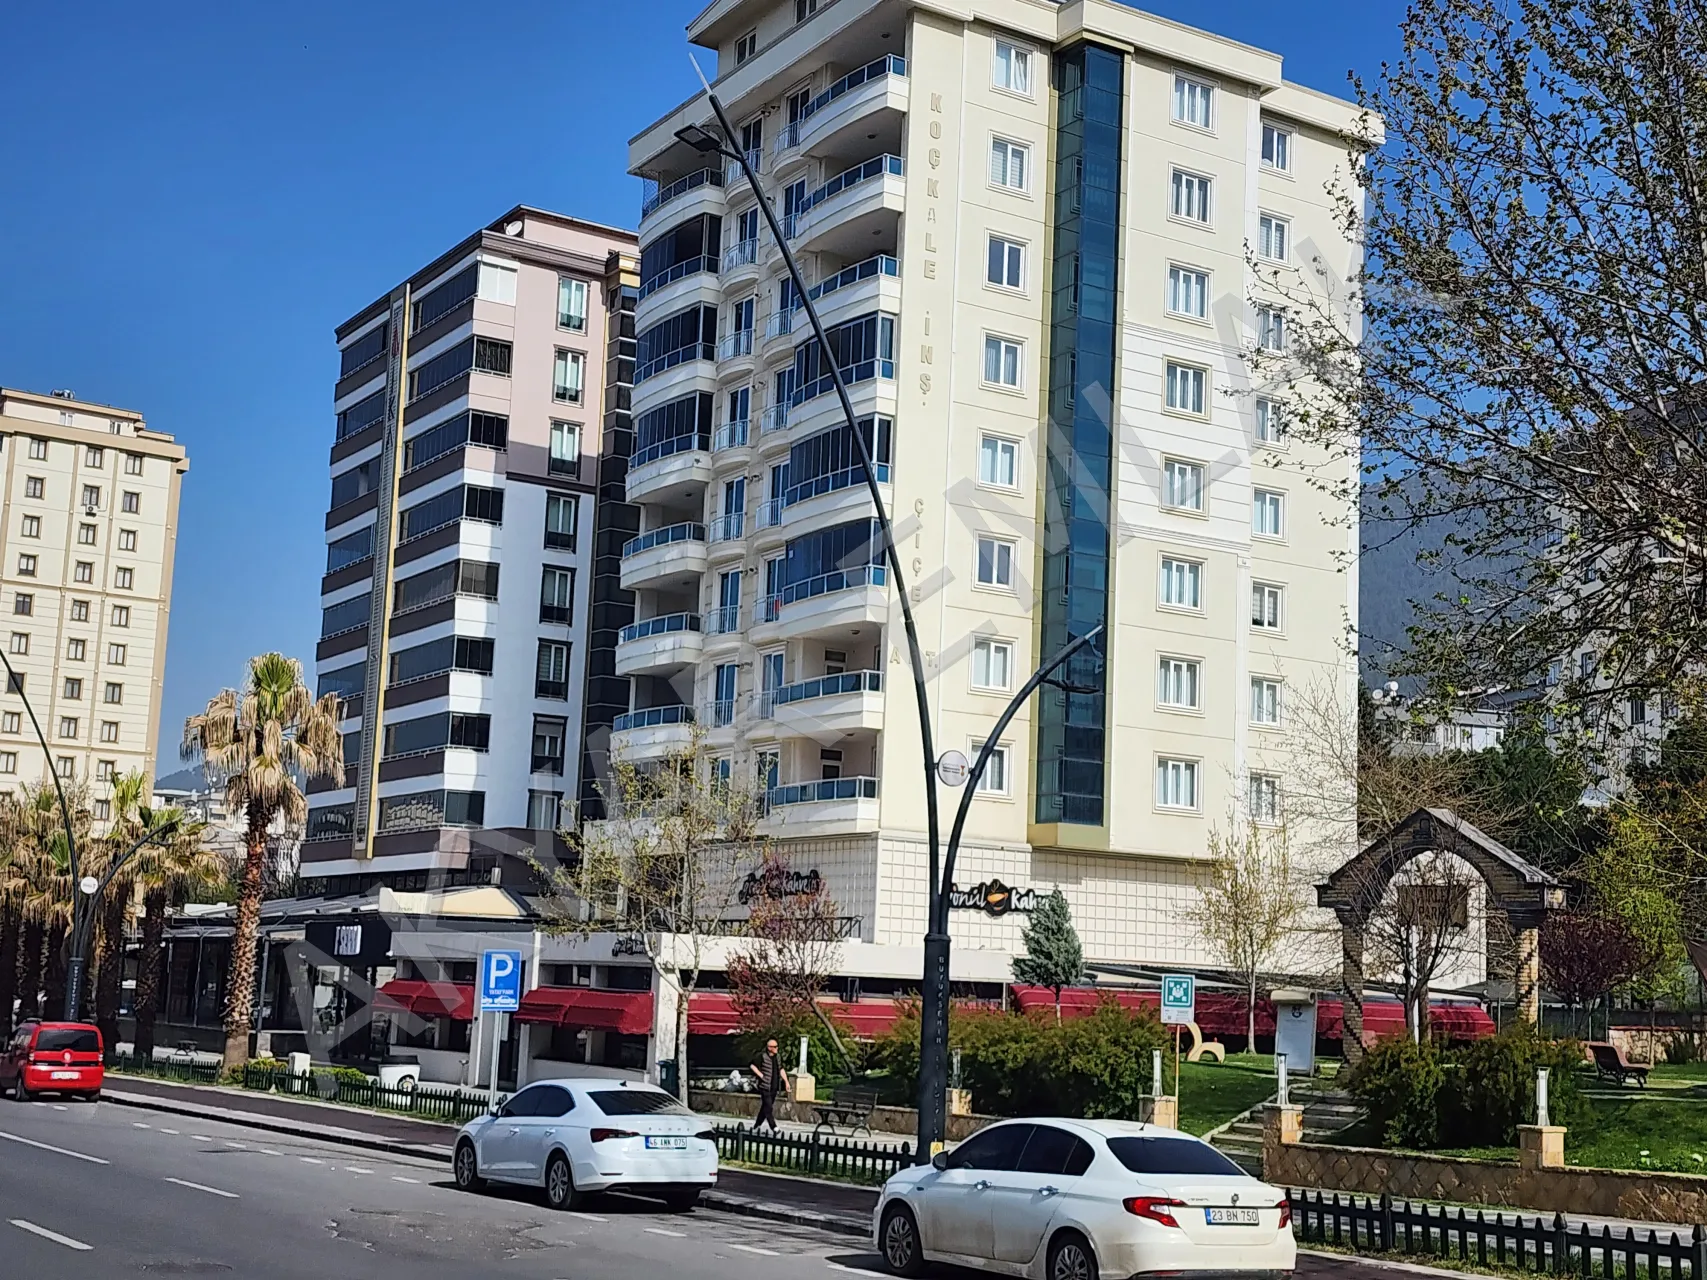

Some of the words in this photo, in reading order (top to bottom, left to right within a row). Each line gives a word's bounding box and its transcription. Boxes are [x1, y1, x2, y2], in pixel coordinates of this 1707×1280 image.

[924, 92, 942, 280] KOÇKALE
[911, 498, 924, 626] ÇİÇE
[890, 646, 939, 668] AT.
[489, 953, 514, 989] P
[1212, 1210, 1223, 1220] 23
[1226, 1210, 1238, 1221] BN
[1240, 1210, 1257, 1221] 750
